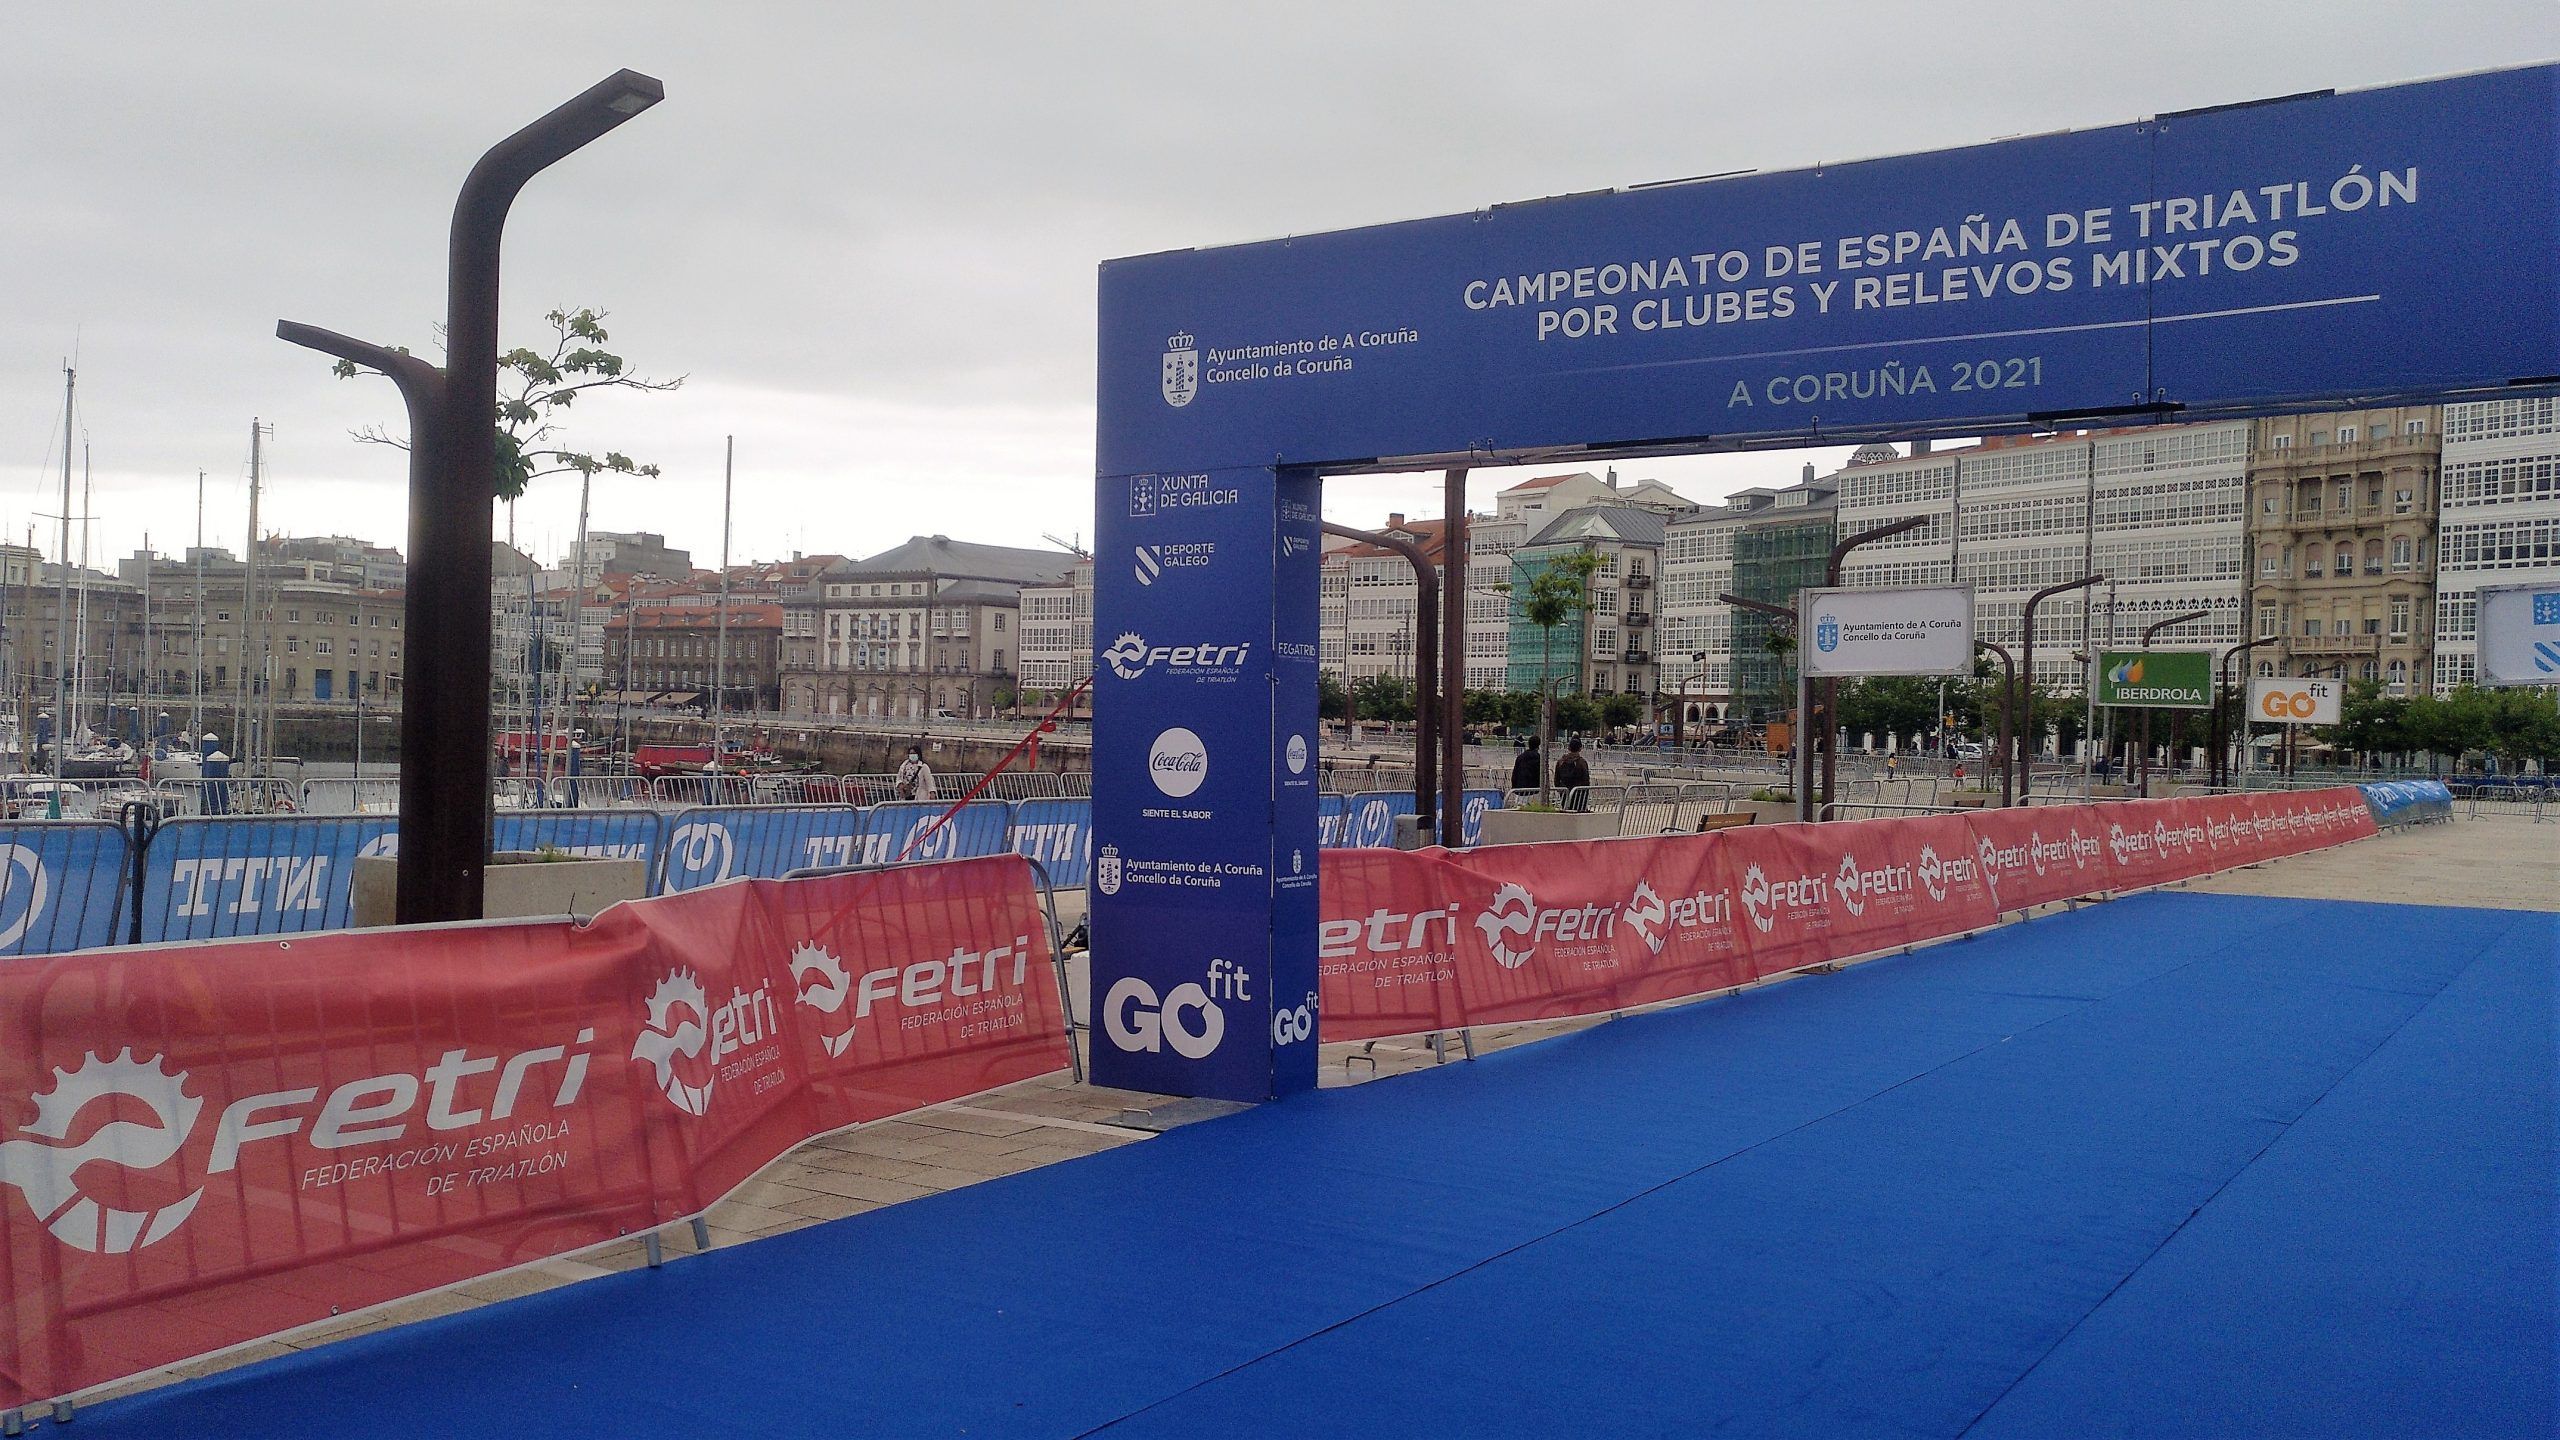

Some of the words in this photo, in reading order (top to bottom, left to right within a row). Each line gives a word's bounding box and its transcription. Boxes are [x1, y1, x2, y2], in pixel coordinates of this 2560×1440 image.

[1463, 249, 1750, 311] CAMPEONATO
[1765, 240, 1822, 278] DE
[1838, 213, 2029, 271] ESPAÑA
[2045, 207, 2112, 248] DE
[2130, 164, 2418, 236] TRIATLÓN
[1537, 304, 1619, 341] POR
[1632, 285, 1796, 332] CLUBES
[1810, 281, 1840, 313] Y
[1853, 257, 2073, 310] RELEVOS
[2092, 230, 2300, 288] MIXTOS
[1206, 340, 1314, 366] Ayuntamiento
[1318, 335, 1338, 351] de
[1342, 333, 1355, 349] A
[1359, 326, 1418, 347] Coruña
[1206, 362, 1269, 384] Concello
[1273, 360, 1292, 377] da
[1297, 354, 1353, 375] Coruña
[1727, 380, 1755, 408] A
[1766, 361, 1937, 404] CORUÑA
[1951, 356, 2043, 393] 2021
[1161, 474, 1208, 491] XUNTA
[1160, 493, 1178, 508] DE
[1181, 489, 1238, 507] GALICIA
[1164, 542, 1215, 555] DEPORTE
[1163, 555, 1209, 567] GALEGO
[1842, 621, 1905, 632] Ayuntamiento
[1906, 620, 1918, 629] de
[1920, 620, 1927, 629] A
[1929, 619, 1962, 629] Coruña
[1843, 632, 1880, 642] Concello
[1881, 631, 1892, 641] da
[1894, 631, 1926, 640] Coruña
[2116, 687, 2202, 700] IBERDROLA
[2262, 690, 2316, 718] GO
[2309, 683, 2328, 698] fit
[1152, 751, 1203, 772] Coca-Cola
[1142, 809, 1170, 818] SIENTE
[1171, 809, 1181, 818] EL
[1182, 810, 1211, 819] SABOR
[1126, 858, 1196, 872] Ayuntamiento
[1198, 862, 1211, 873] de
[1214, 863, 1222, 874] A
[1225, 863, 1263, 875] Coruña
[1126, 872, 1167, 885] Concello
[1169, 874, 1182, 886] da
[1184, 875, 1221, 887] Coruña
[1319, 902, 1460, 957] etri
[1319, 957, 1387, 977] EDERACIÓN
[1392, 951, 1456, 968] ESPAÑOLA
[1374, 976, 1393, 988] DE
[901, 1003, 968, 1031] FEDERACIÓN
[972, 992, 1023, 1015] ESPAÑOLA
[1103, 976, 1225, 1059] GO
[1207, 958, 1251, 1001] fit
[1273, 1004, 1312, 1046] GO
[1306, 990, 1319, 1011] fit
[960, 1024, 974, 1039] DE
[301, 1141, 459, 1190] FEDERACIÓN
[464, 1119, 570, 1159] ESPAÑOLA
[426, 1172, 455, 1197] DE
[466, 1150, 568, 1187] TRIATLÓN
